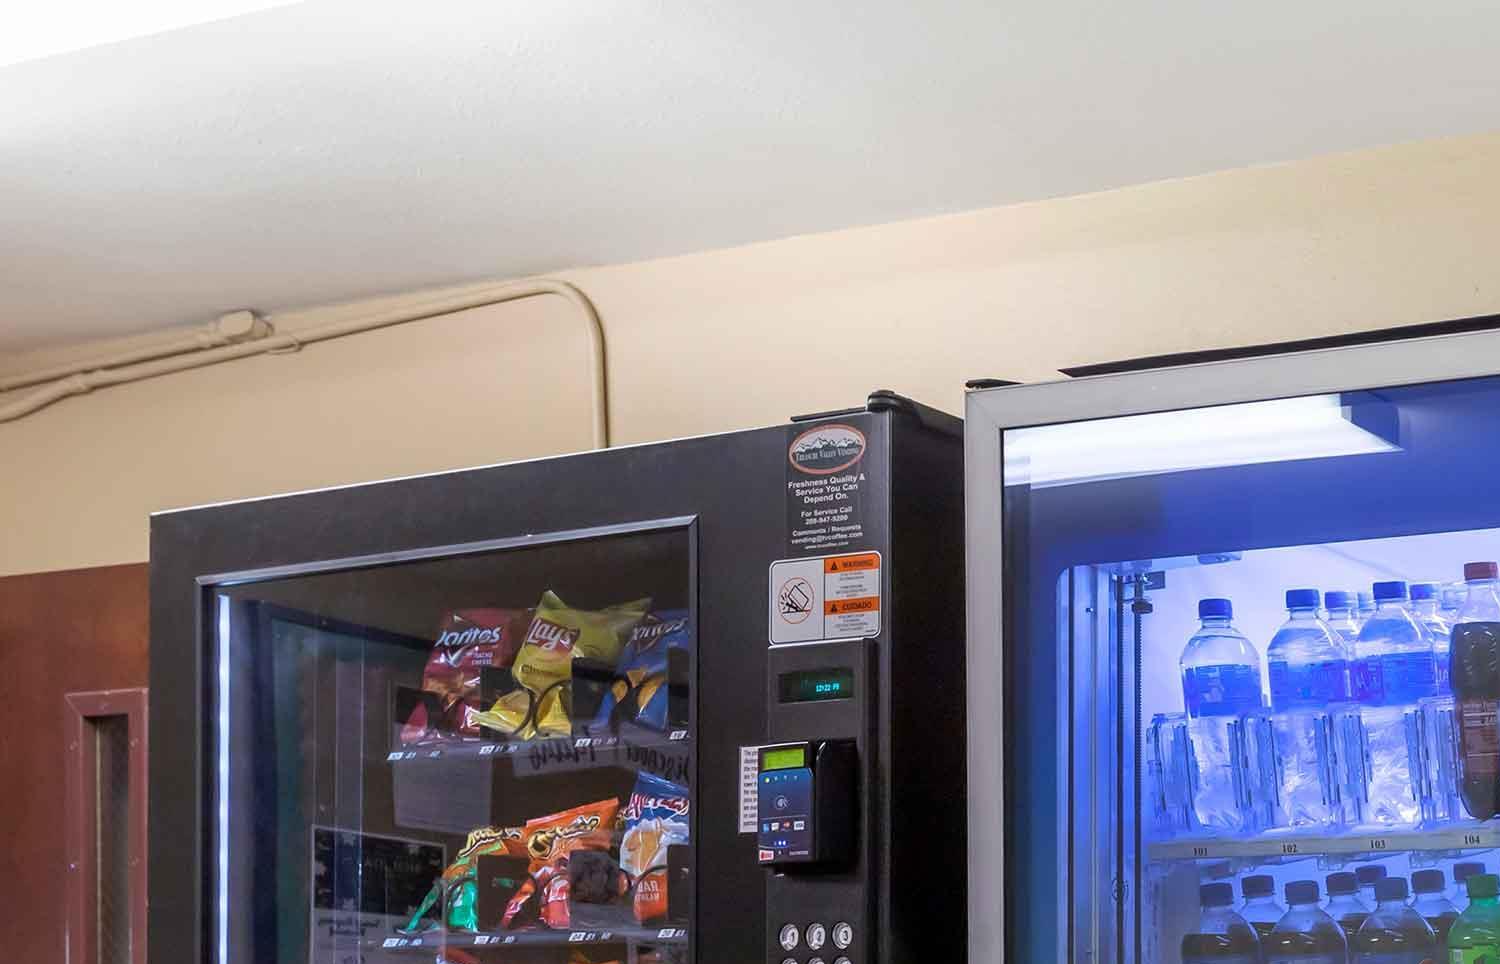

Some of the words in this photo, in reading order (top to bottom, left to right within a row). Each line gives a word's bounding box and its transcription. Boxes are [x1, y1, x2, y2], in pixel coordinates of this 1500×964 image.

[788, 479, 828, 489] Freshness
[829, 474, 858, 484] Quality
[795, 488, 824, 497] Service
[842, 483, 858, 491] Can
[803, 494, 834, 504] Depend
[1464, 835, 1480, 844] 104
[1282, 844, 1297, 853] 102
[1370, 840, 1386, 849] 103
